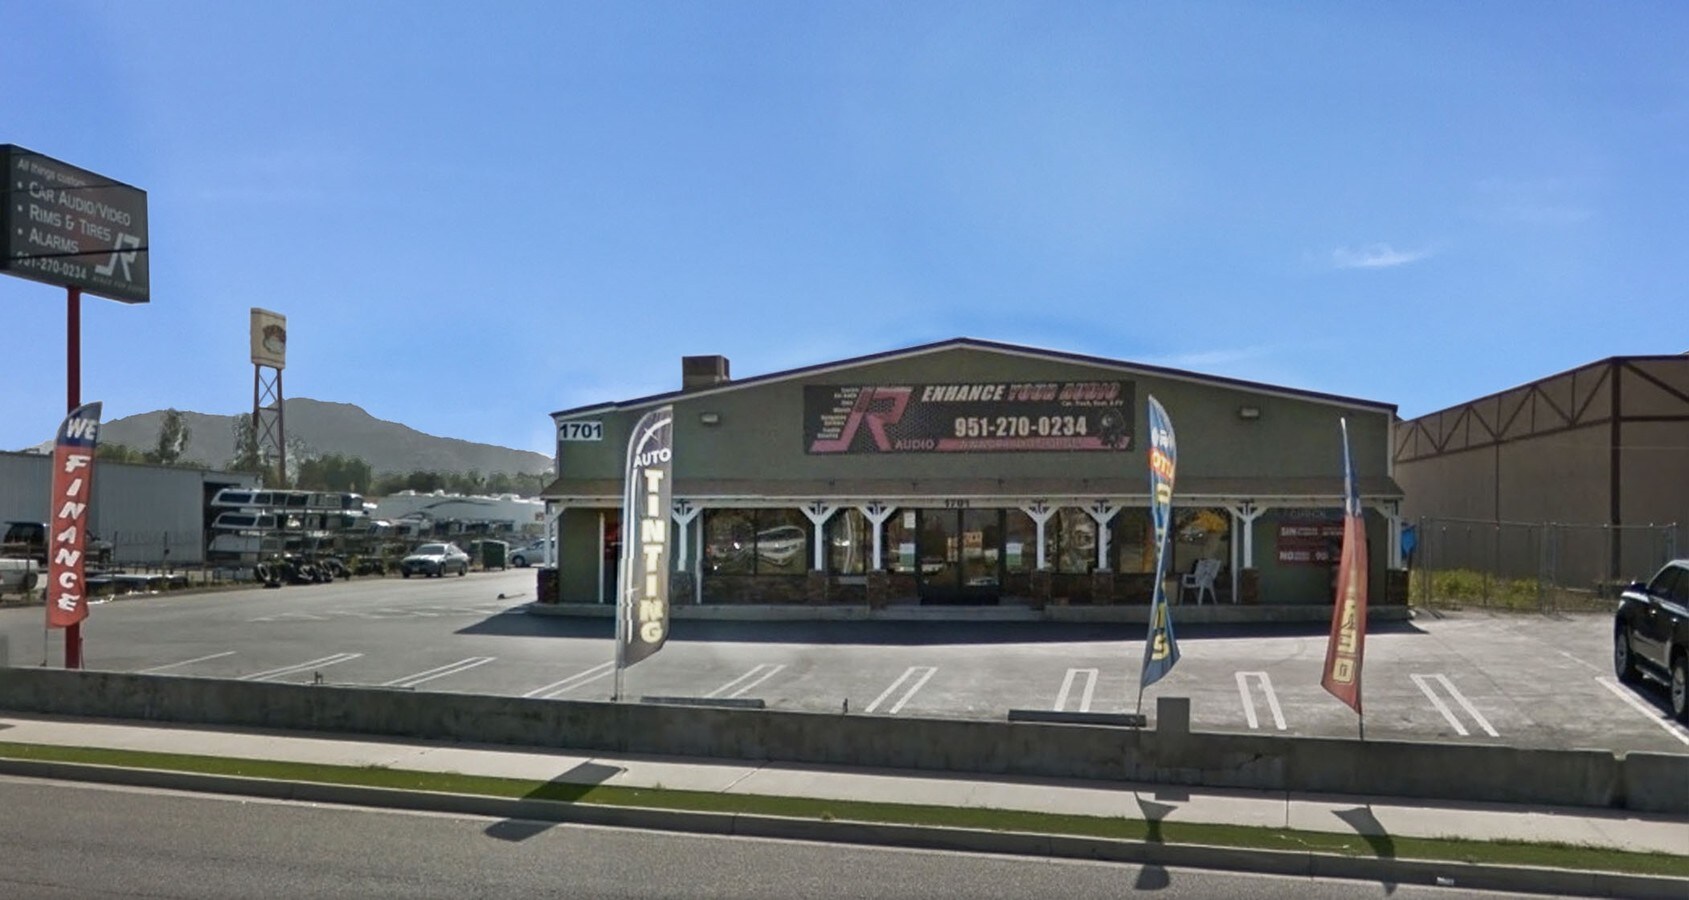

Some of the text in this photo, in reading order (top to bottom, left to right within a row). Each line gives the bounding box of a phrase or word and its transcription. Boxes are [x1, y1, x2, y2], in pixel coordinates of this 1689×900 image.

[29, 181, 131, 226] CAR AUDIO/VIDEO
[29, 204, 112, 241] RIMS & TIRES
[29, 227, 79, 253] ALARMS
[921, 385, 1005, 402] ENHANCE
[65, 417, 97, 441] WE
[560, 423, 602, 438] 1701
[955, 416, 1087, 437] 951-270-0234
[895, 439, 936, 450] AUDIO
[633, 447, 671, 469] AUTO
[945, 499, 970, 508] 1701
[54, 454, 92, 612] FINANCE
[638, 468, 666, 643] TINTING
